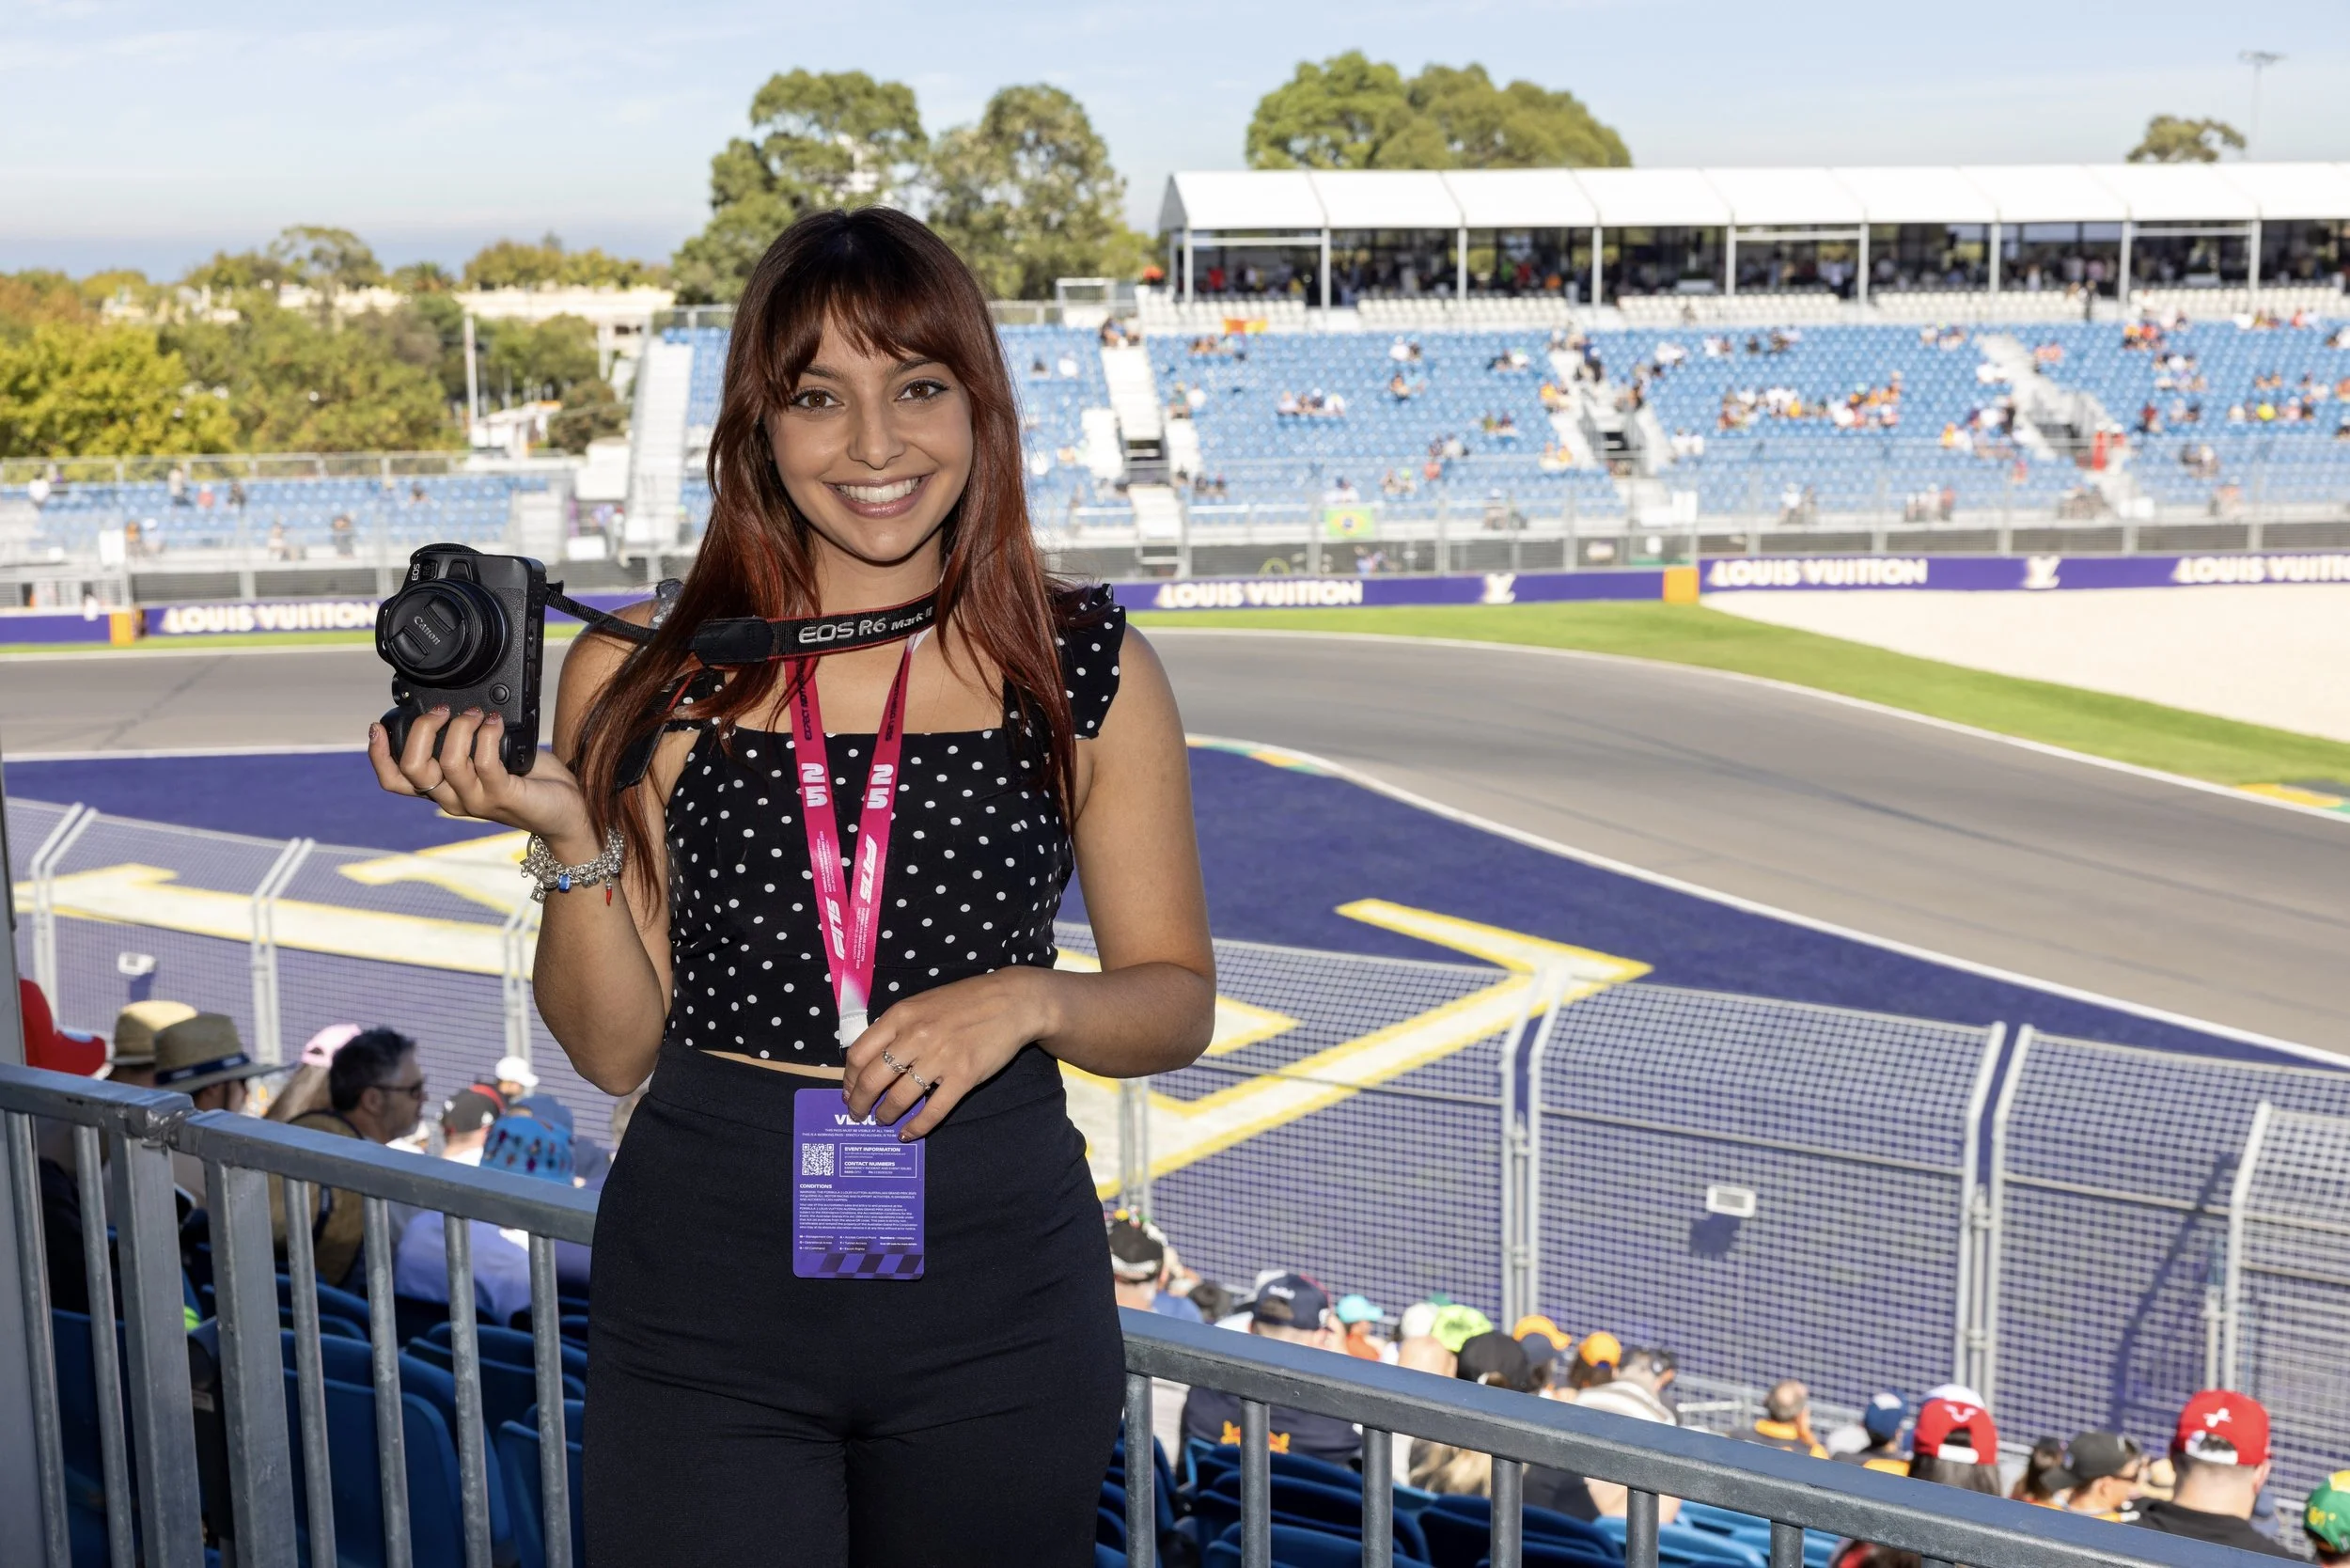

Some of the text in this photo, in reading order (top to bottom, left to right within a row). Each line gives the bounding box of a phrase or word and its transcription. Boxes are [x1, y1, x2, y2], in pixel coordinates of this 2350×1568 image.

[412, 564, 420, 581] EOS
[1709, 558, 1928, 586] LOUIS VUITTON
[2171, 557, 2265, 584] LOUIS
[1154, 580, 1363, 608] LOUIS VUITTON
[162, 605, 254, 633] LOUIS
[414, 616, 441, 646] Canon
[799, 606, 933, 644] EOS R6 Mark II
[801, 762, 828, 808] 25
[867, 763, 894, 809] 25
